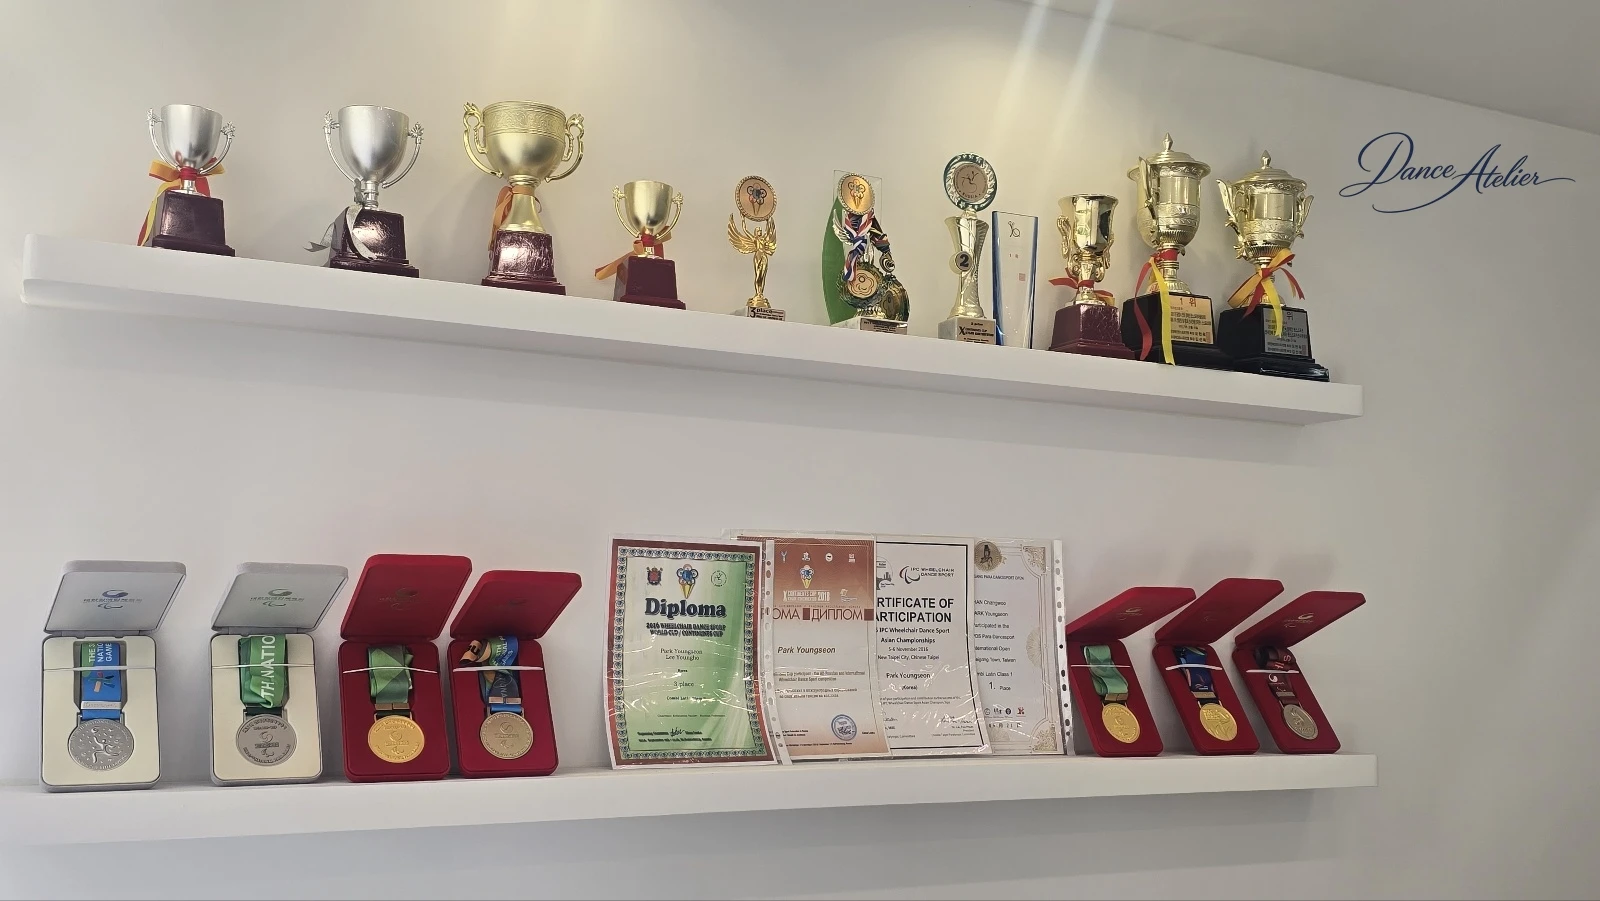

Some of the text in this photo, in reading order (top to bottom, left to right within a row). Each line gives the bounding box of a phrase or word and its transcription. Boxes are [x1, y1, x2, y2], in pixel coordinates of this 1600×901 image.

[959, 254, 969, 267] 2
[750, 307, 756, 318] 3
[645, 597, 727, 620] Diploma
[938, 598, 954, 609] OF
[811, 608, 863, 622] ДИПЛОМ
[260, 635, 276, 678] NATIO
[777, 646, 836, 655] Park Youngseon
